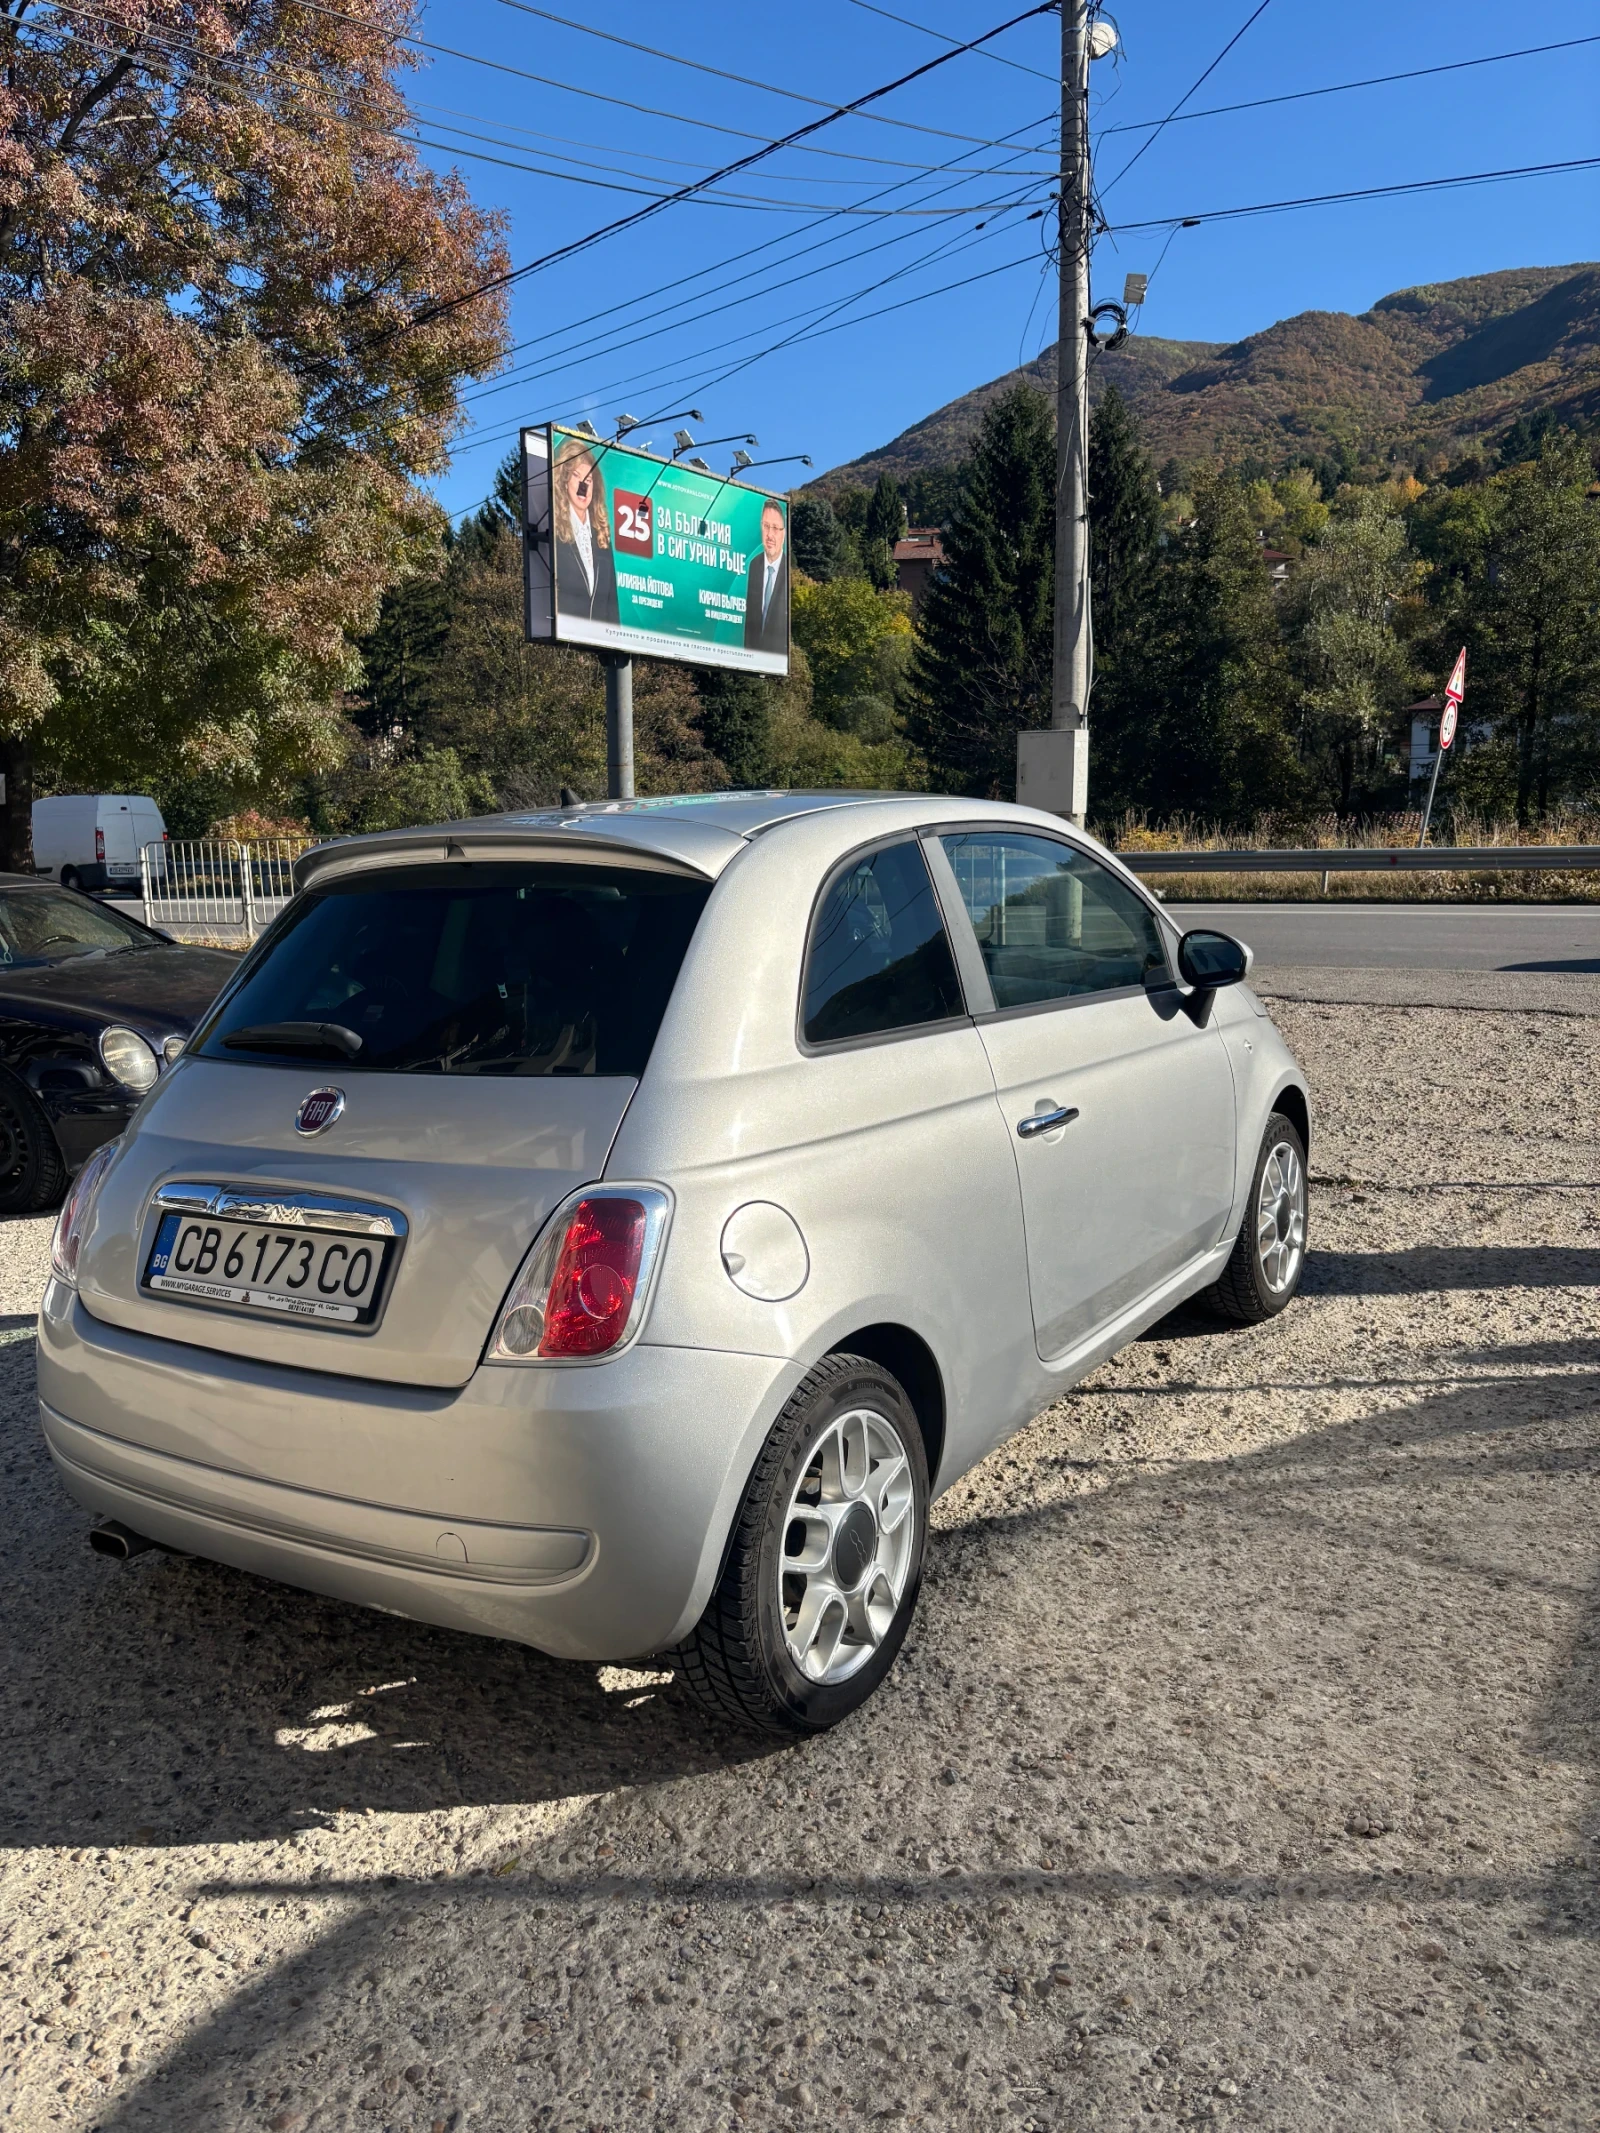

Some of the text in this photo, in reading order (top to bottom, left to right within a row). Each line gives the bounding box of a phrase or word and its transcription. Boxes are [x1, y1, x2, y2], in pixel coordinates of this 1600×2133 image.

[618, 505, 650, 542] 25
[657, 506, 672, 530] ЗА
[657, 533, 747, 576] В СИГУРНИ РЪЦЕ
[616, 571, 675, 598] ИЛИЯНА ЙОТОВА
[631, 595, 638, 605] ЗА
[699, 589, 747, 612] КИРИЛ ВЪЛЧЕВ
[303, 1100, 333, 1122] FIAT
[152, 1253, 169, 1269] BG
